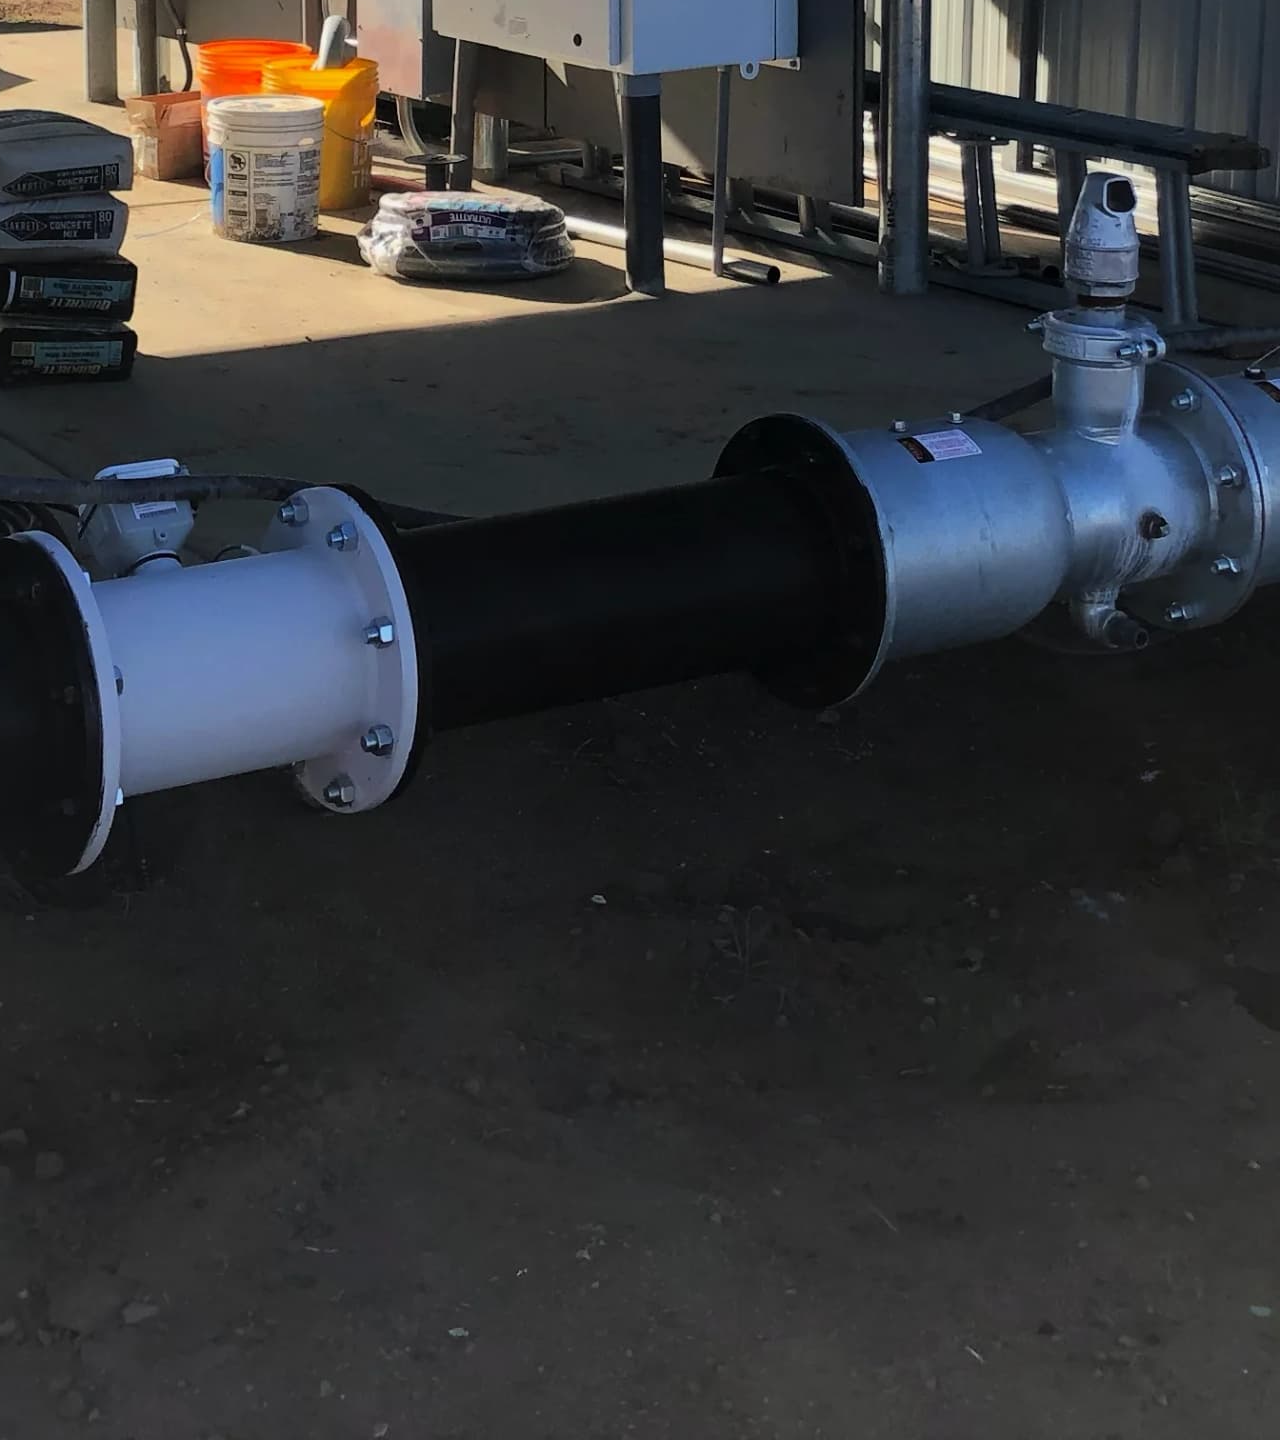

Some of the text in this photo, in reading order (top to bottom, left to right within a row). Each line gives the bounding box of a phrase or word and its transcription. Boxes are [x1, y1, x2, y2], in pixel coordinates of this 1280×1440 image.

[57, 175, 99, 186] CONCRETE
[98, 211, 112, 222] 80
[49, 221, 93, 231] CONCRETE
